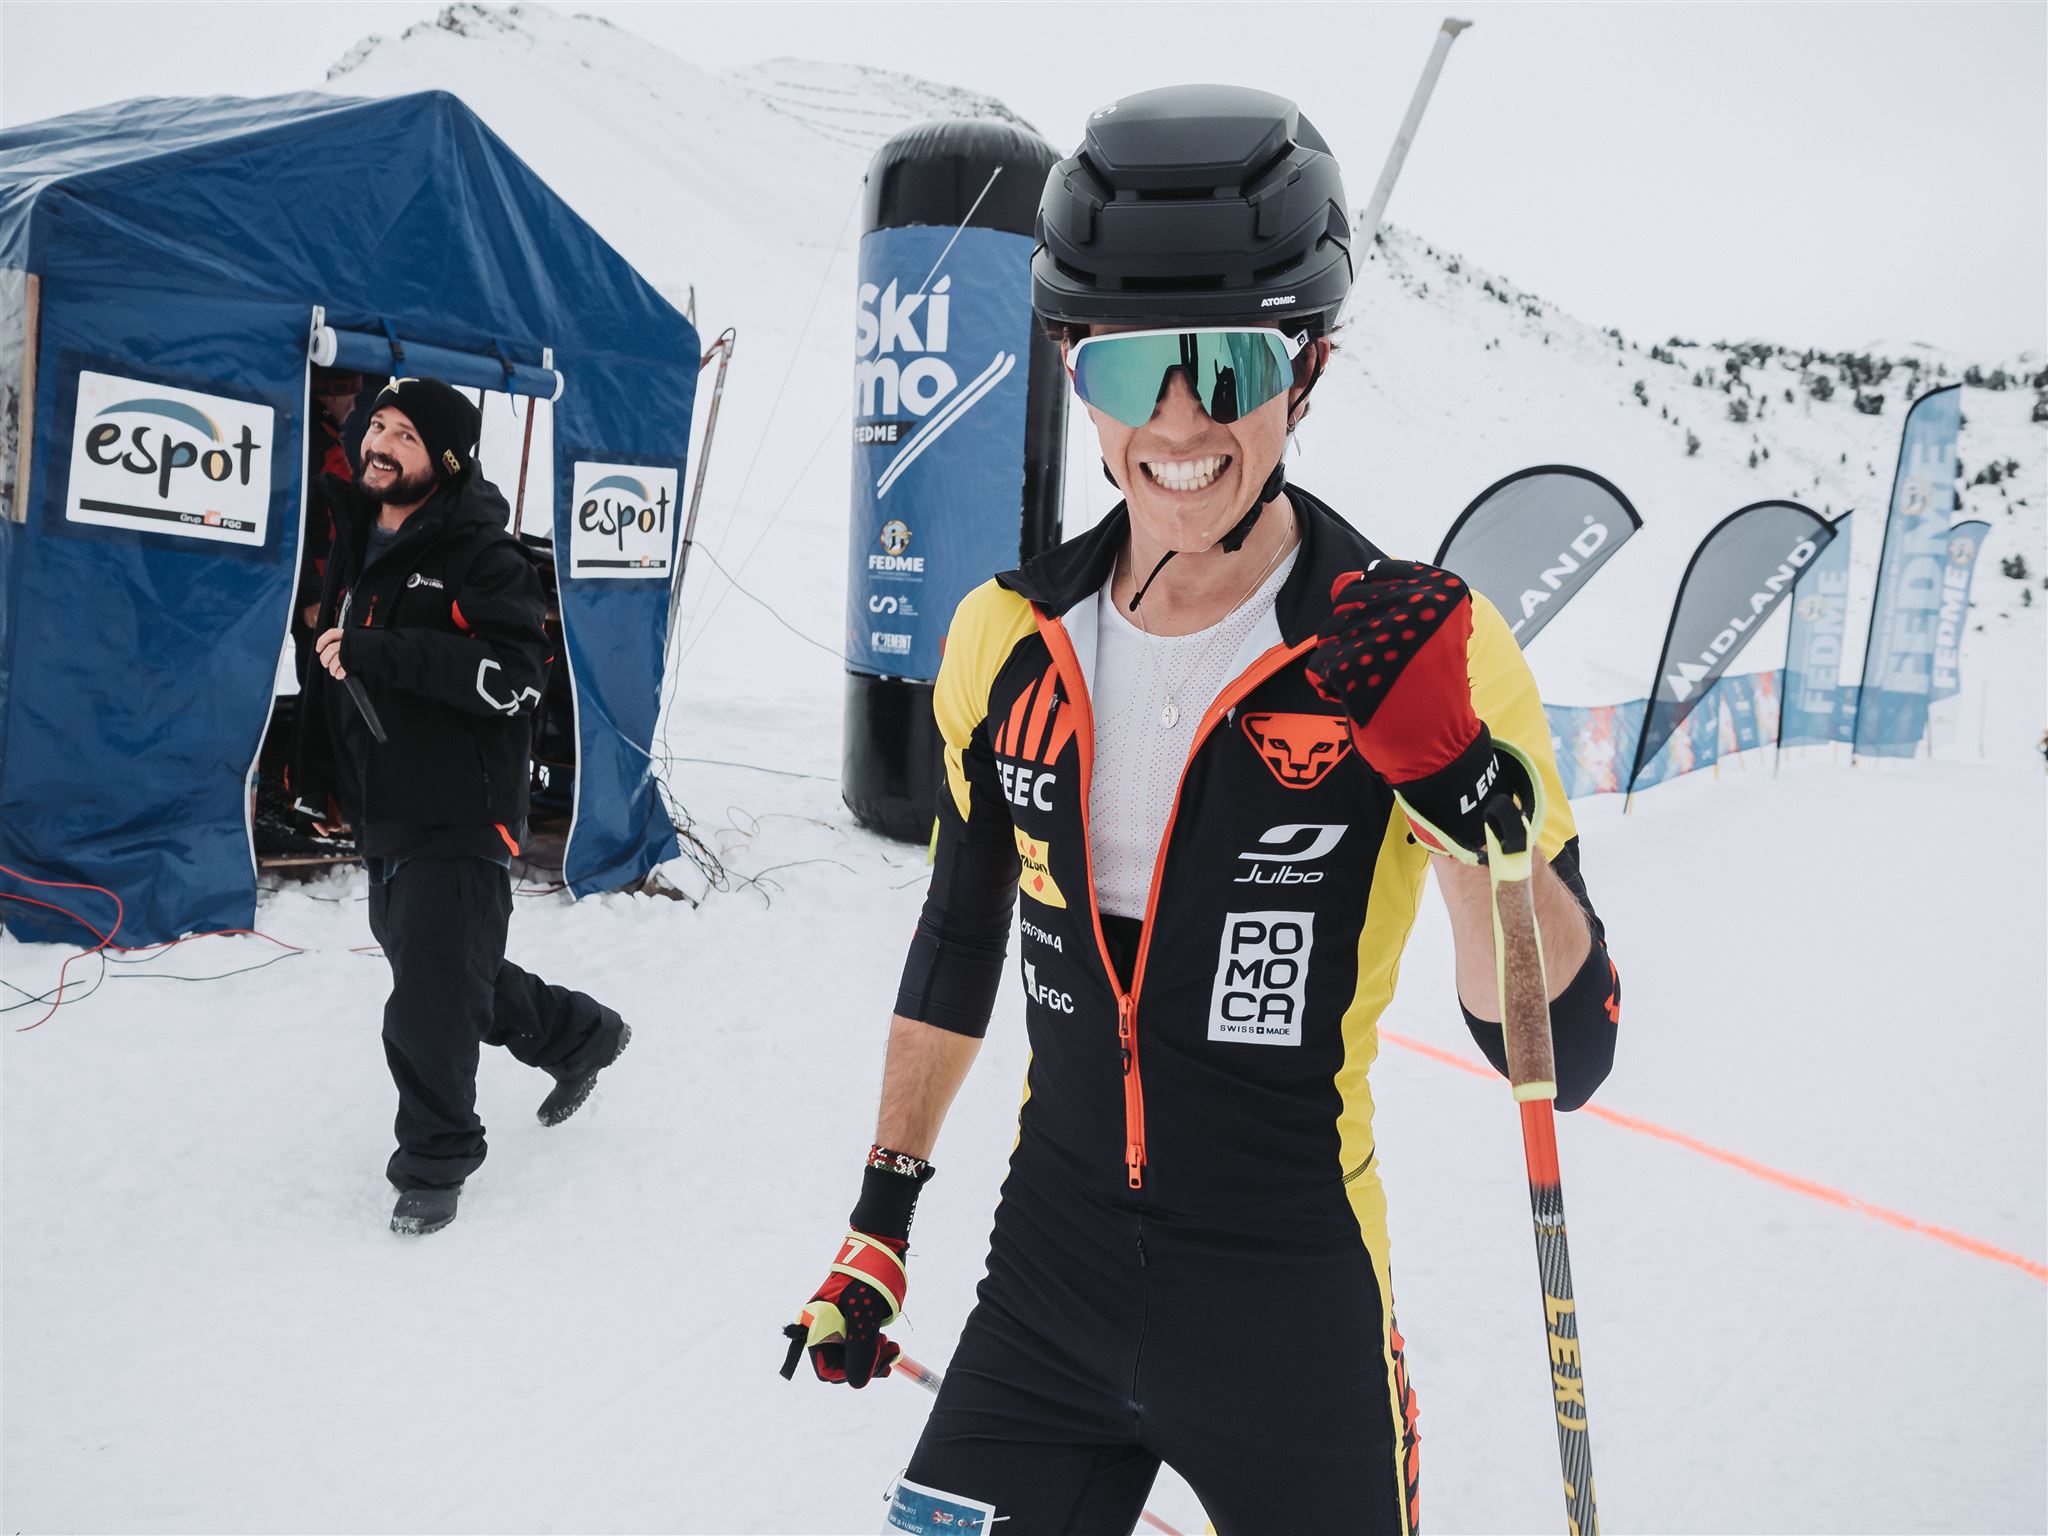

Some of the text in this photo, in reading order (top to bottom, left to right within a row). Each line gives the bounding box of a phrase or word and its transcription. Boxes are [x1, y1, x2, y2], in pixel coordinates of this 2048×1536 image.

[856, 274, 951, 357] Ski
[1261, 295, 1296, 307] ATOMIC
[85, 423, 262, 499] espot
[180, 513, 242, 529] Grup FGC
[579, 486, 671, 551] espot
[869, 555, 924, 572] FEDME
[1666, 540, 1817, 702] MIDLAND
[1932, 565, 1969, 689] FEDME
[1460, 753, 1499, 815] LEKI
[1233, 864, 1324, 884] Julbo
[1230, 920, 1303, 955] PO
[1224, 958, 1299, 990] MO
[1039, 985, 1074, 1014] FGC
[1221, 991, 1295, 1024] CA
[1220, 1025, 1291, 1036] SWISS MADE
